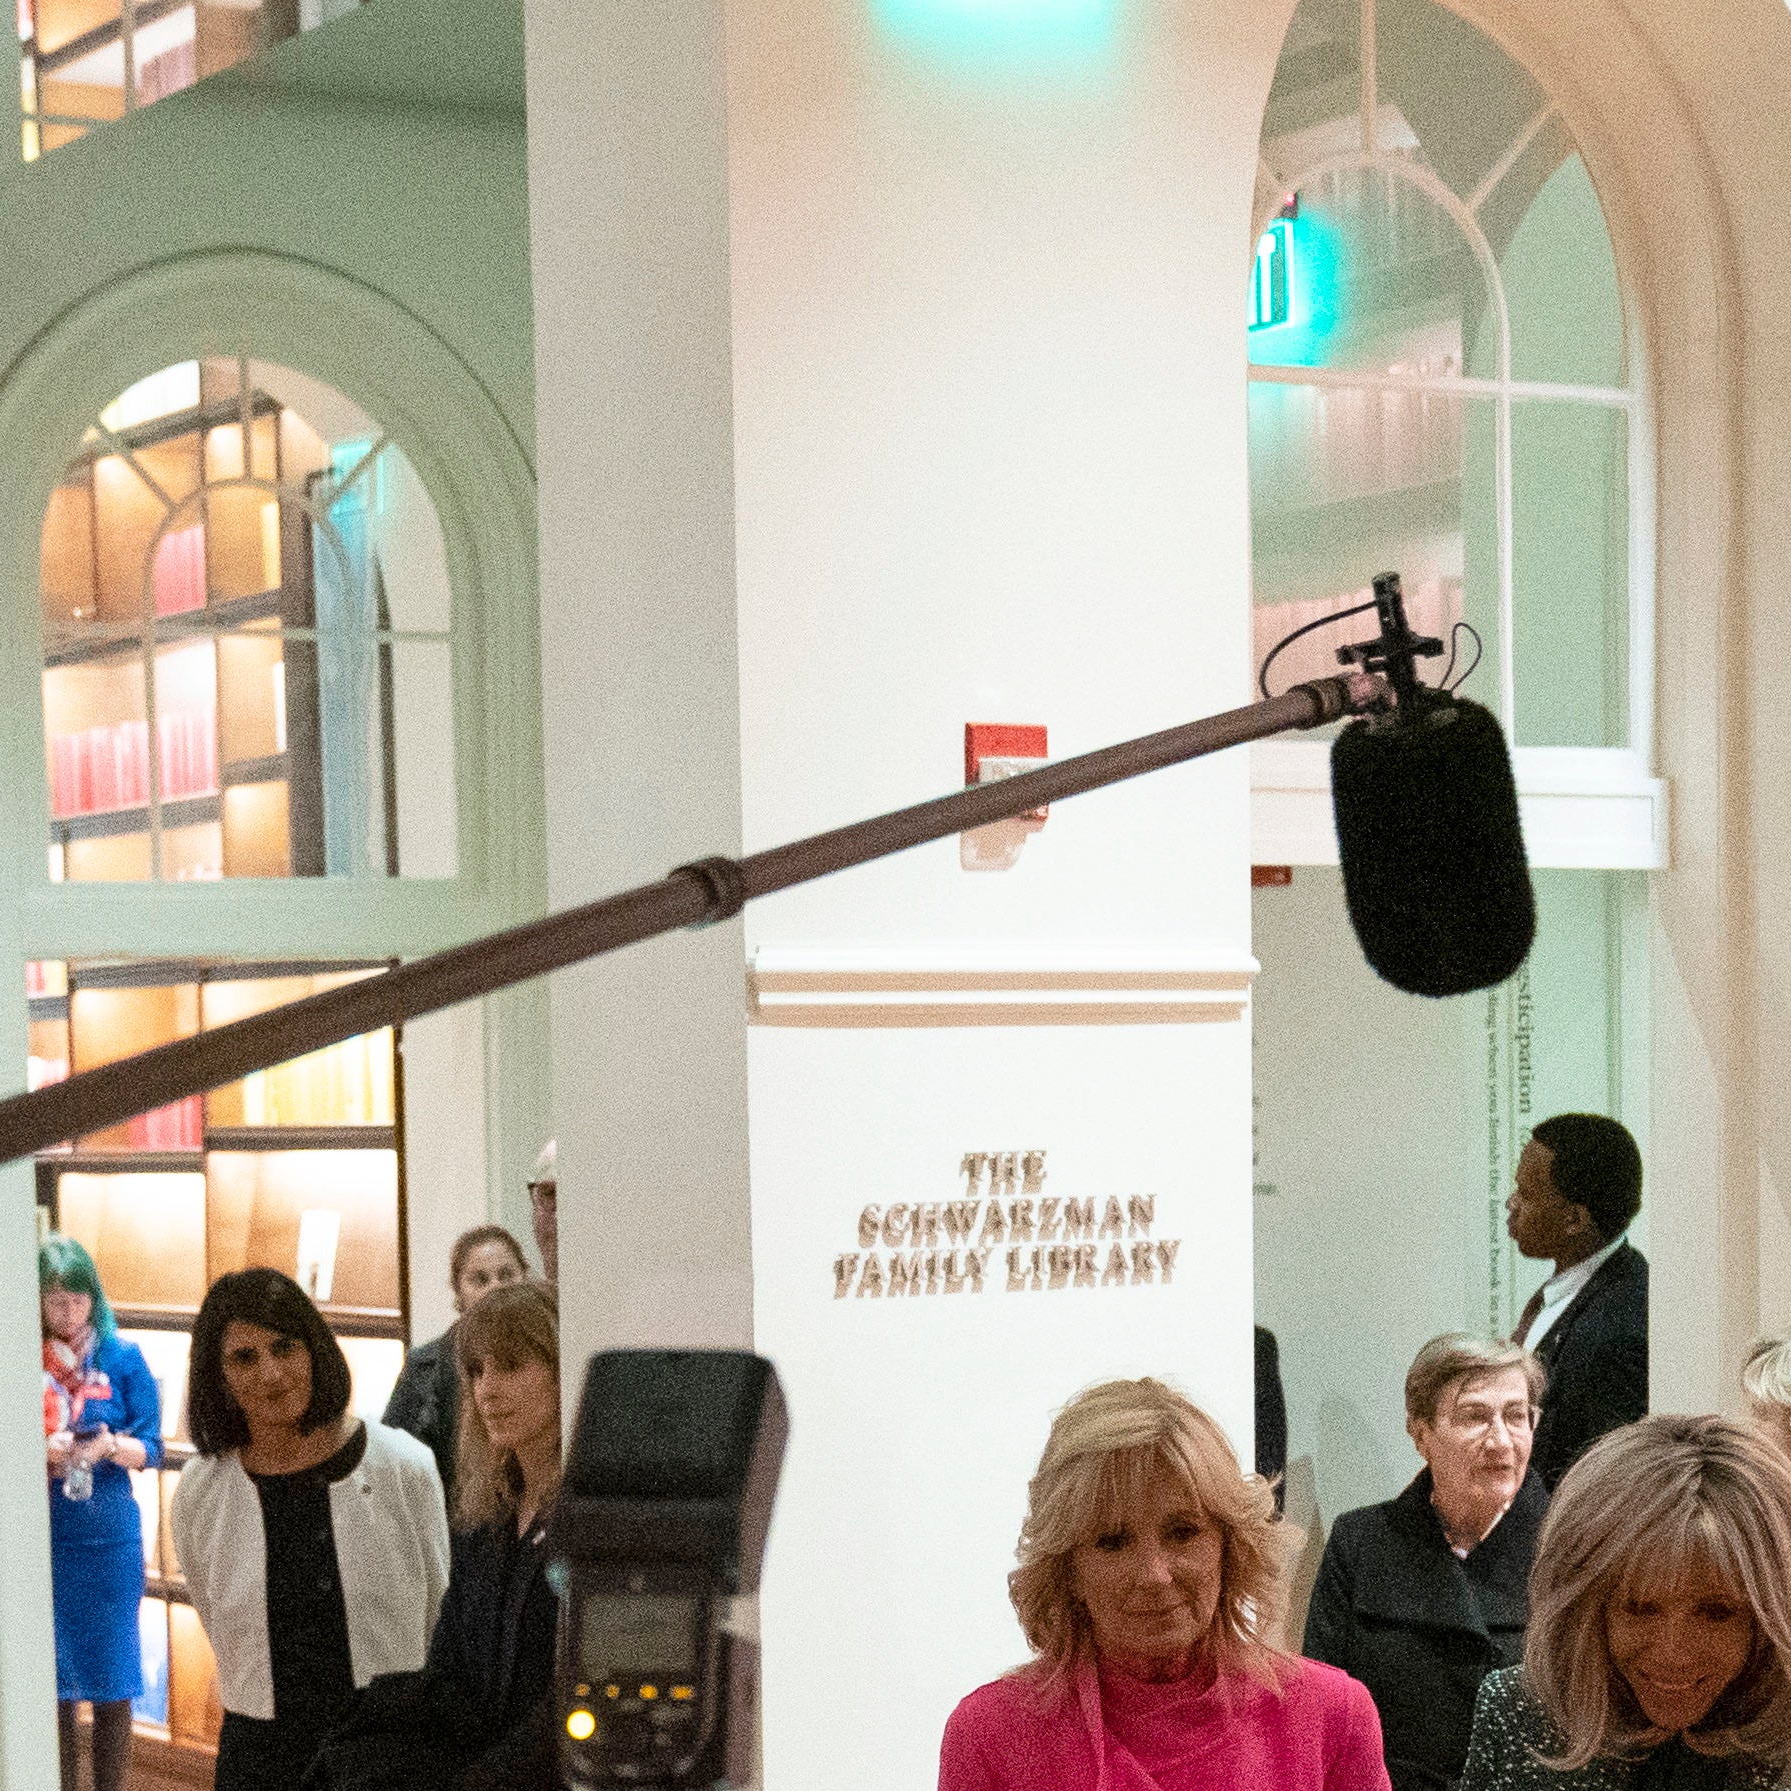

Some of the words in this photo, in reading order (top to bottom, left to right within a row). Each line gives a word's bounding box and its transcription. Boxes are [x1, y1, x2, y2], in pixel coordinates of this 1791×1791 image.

[959, 1150, 1047, 1197] THE
[858, 1194, 1156, 1249] SCHWARZMAN
[833, 1247, 994, 1300] FAMILY
[1006, 1239, 1181, 1292] LIBRARY
